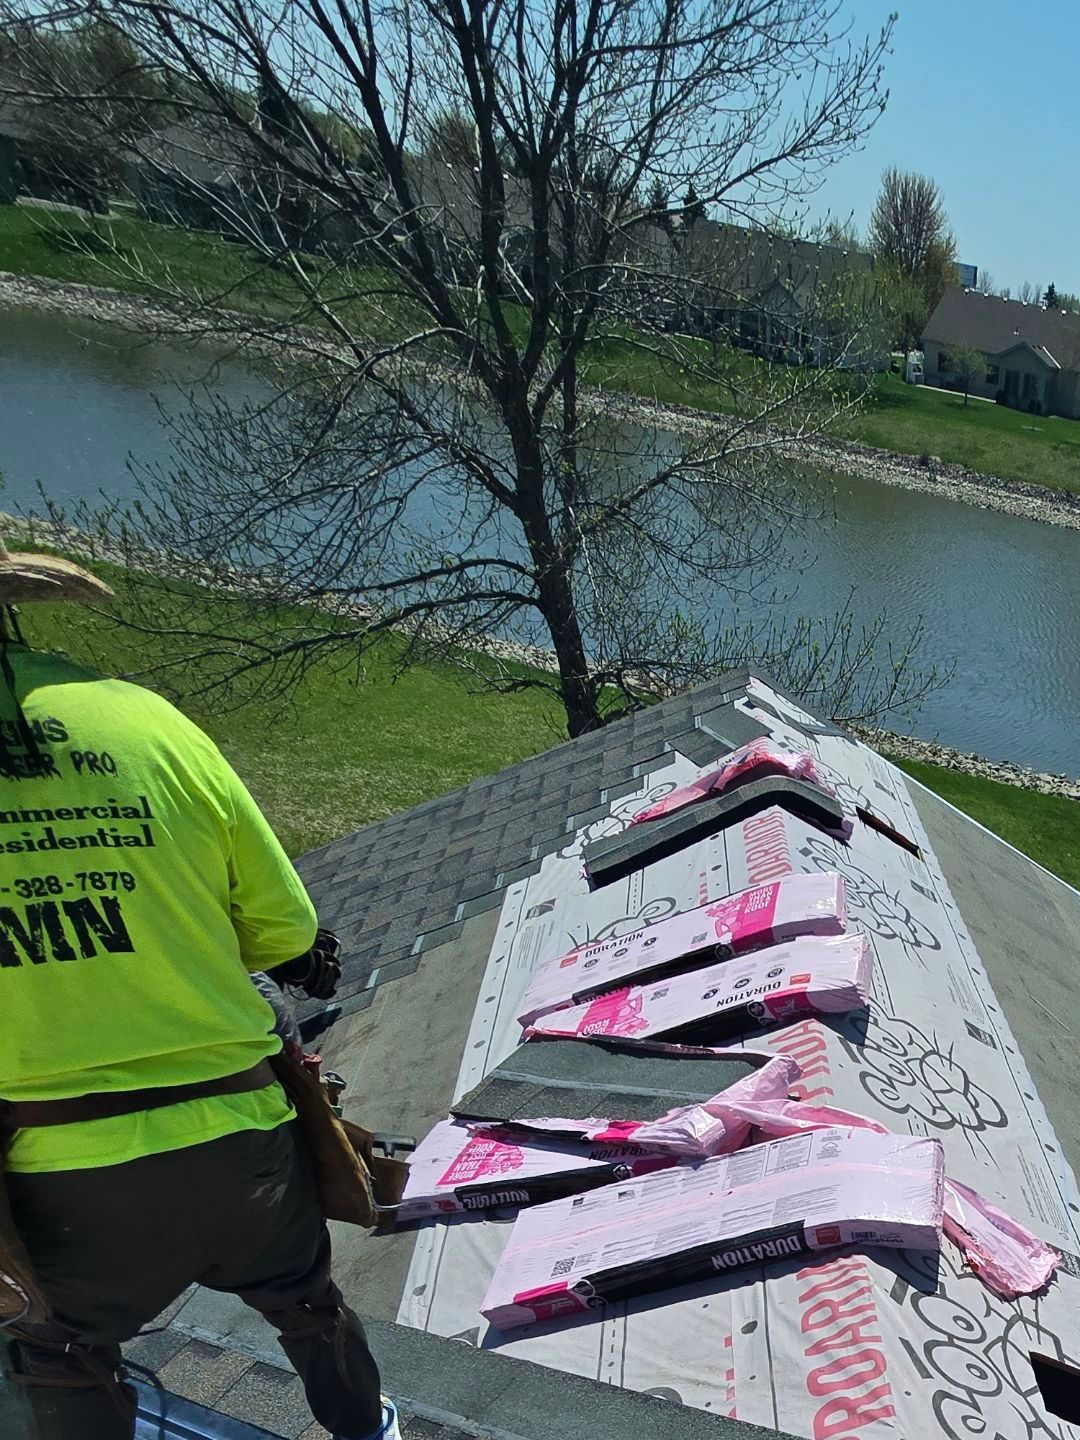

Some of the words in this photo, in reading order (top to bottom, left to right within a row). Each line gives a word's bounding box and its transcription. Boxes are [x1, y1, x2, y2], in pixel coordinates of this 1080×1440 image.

[69, 750, 119, 778] PRO
[584, 931, 645, 959] DURATION
[717, 980, 782, 1008] DURATION
[711, 1234, 801, 1270] DURATION
